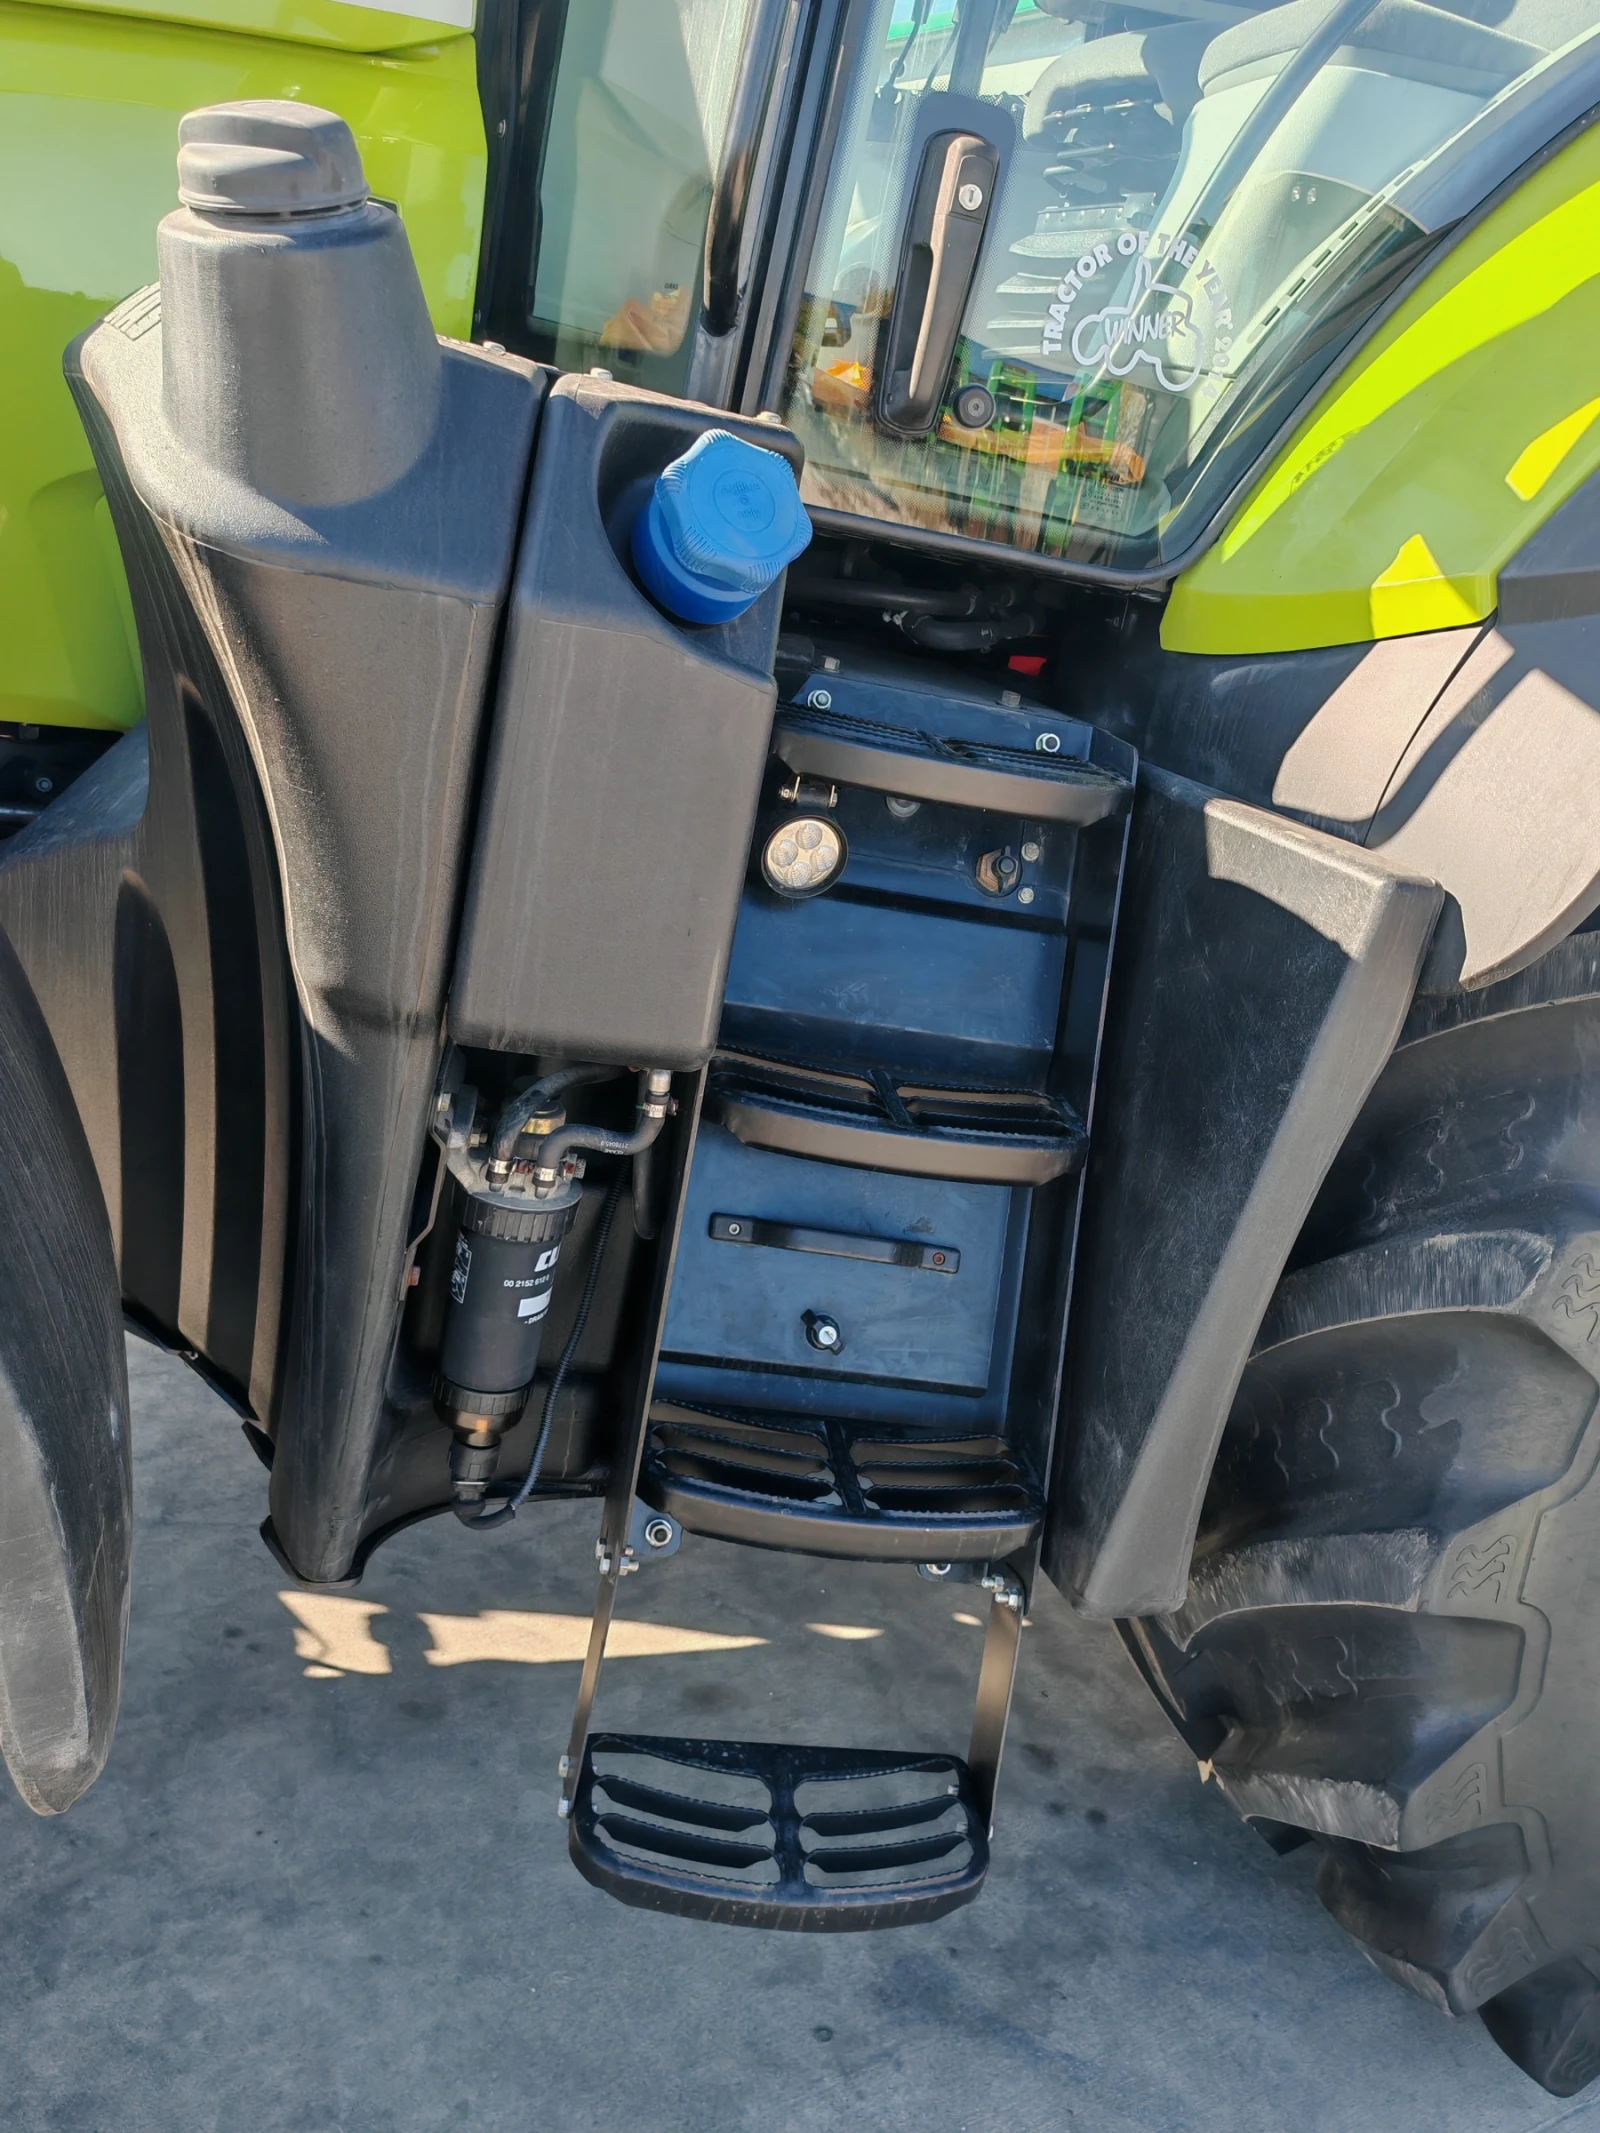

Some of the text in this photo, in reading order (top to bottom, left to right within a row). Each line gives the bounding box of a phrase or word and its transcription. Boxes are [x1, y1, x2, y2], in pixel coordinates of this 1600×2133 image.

[1043, 243, 1113, 355] TRACTOR
[1117, 231, 1150, 255] OF
[1157, 233, 1199, 269] THE
[1104, 311, 1187, 345] WINNER
